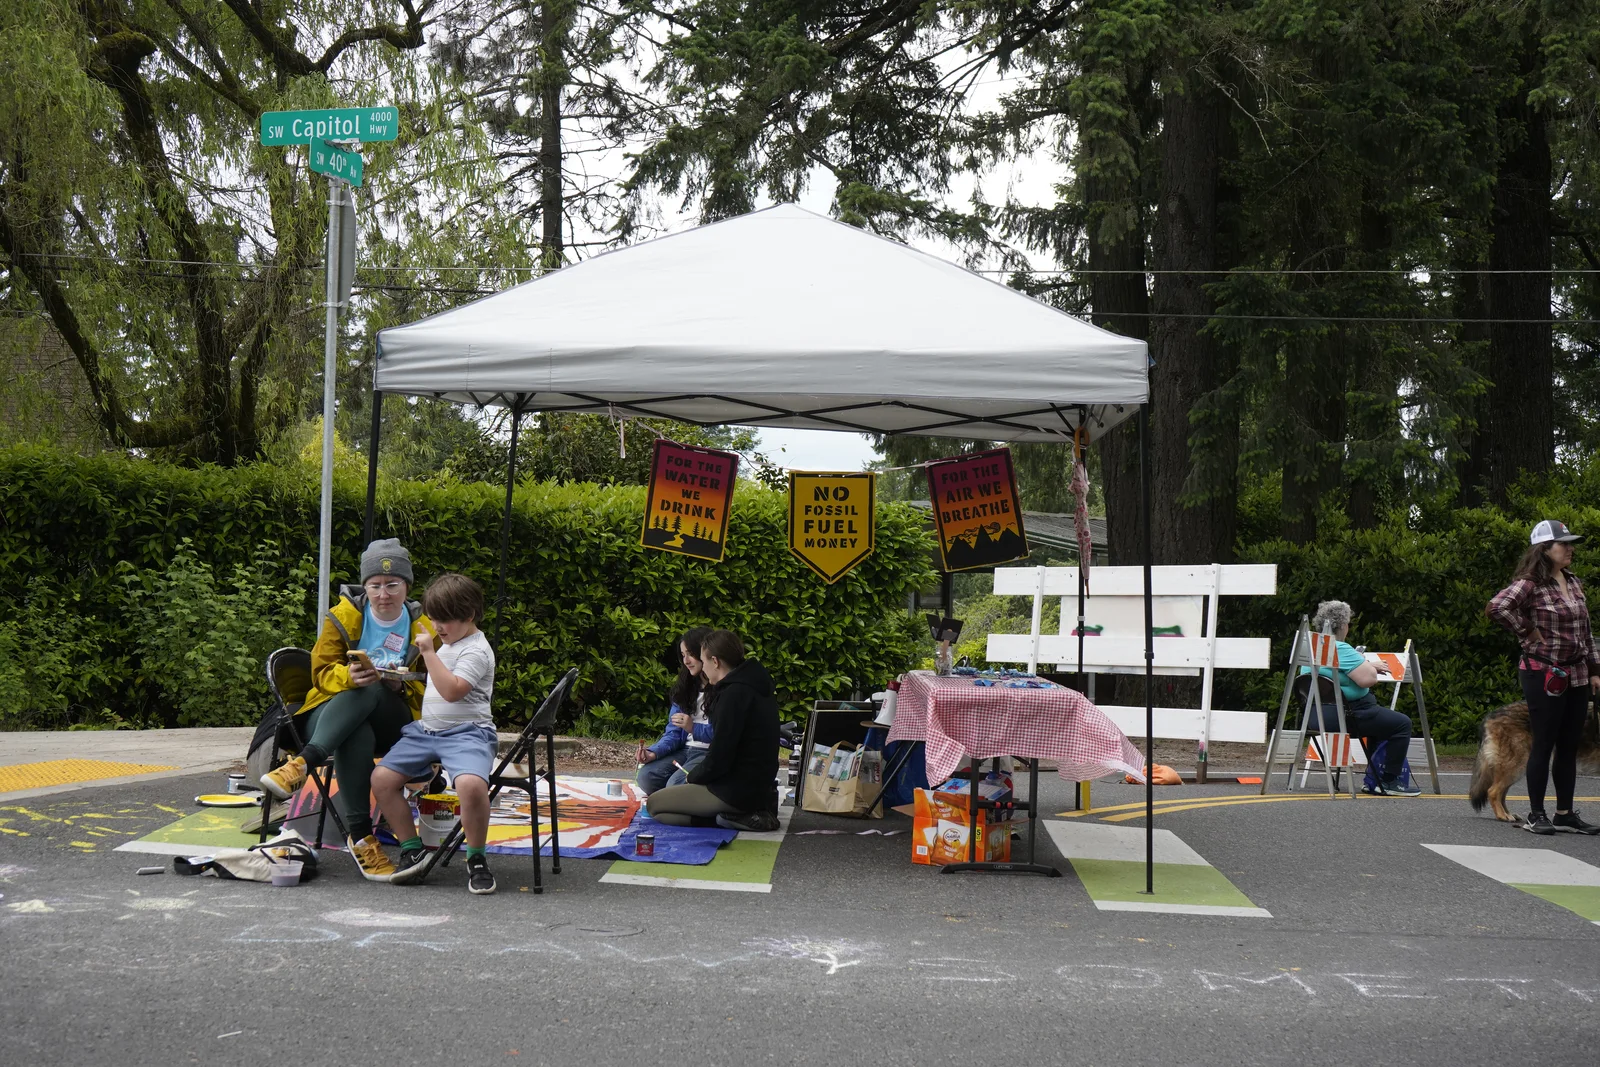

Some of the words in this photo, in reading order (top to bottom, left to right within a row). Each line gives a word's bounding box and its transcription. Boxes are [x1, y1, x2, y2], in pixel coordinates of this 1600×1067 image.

[370, 111, 392, 122] 4000
[268, 126, 284, 139] SW
[292, 115, 360, 138] Capitol
[369, 124, 387, 136] Hwy
[316, 151, 325, 166] SW
[666, 455, 693, 469] FOR
[697, 461, 722, 474] THE
[665, 469, 720, 490] WATER
[941, 470, 968, 484] FOR
[972, 463, 999, 478] THE
[681, 488, 700, 500] WE
[814, 486, 850, 502] NO
[946, 486, 974, 504] AIR
[977, 481, 1002, 498] WE
[660, 499, 716, 520] DRINK
[804, 505, 858, 516] FOSSIL
[942, 499, 1010, 524] BREATHE
[804, 519, 858, 534] FUEL
[804, 538, 858, 548] MONEY
